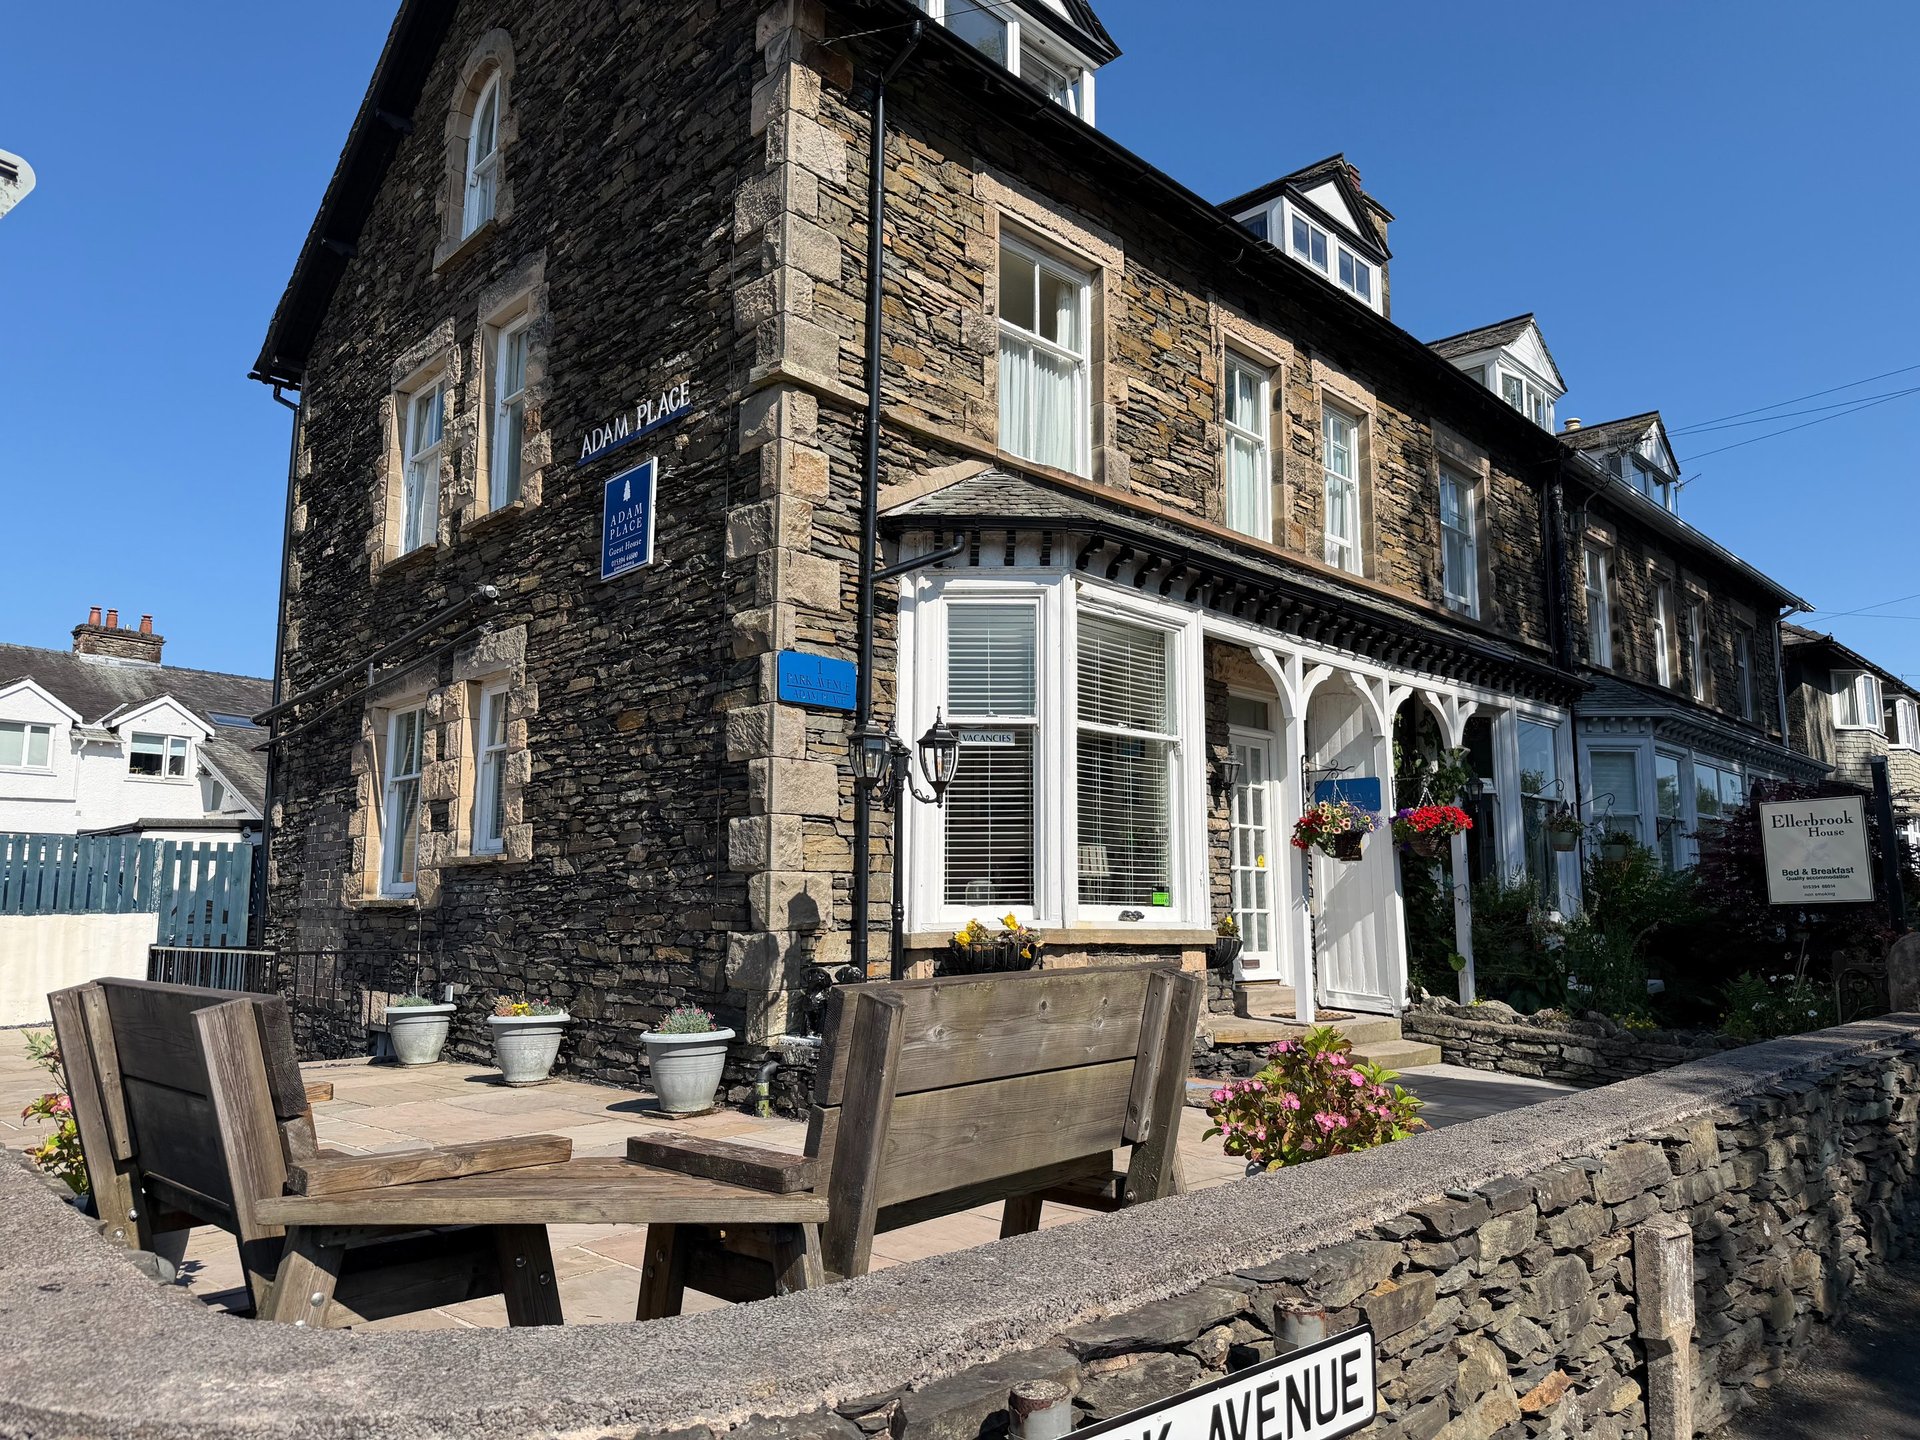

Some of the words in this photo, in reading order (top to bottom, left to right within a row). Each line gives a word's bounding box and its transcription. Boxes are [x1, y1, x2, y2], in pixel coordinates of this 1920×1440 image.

[581, 413, 629, 459] ADAM
[636, 380, 690, 431] PLACE
[610, 502, 643, 527] ADAM
[610, 516, 643, 540] PLACE
[608, 545, 624, 557] Guest
[625, 539, 642, 551] House
[786, 672, 813, 687] PARK
[815, 677, 851, 693] AVENUE
[793, 689, 819, 702] ADAM
[962, 733, 1011, 742] VACANCIES
[1771, 810, 1854, 829] Ellerbrook
[1808, 827, 1845, 838] House
[1781, 868, 1799, 877] Bed
[1801, 868, 1809, 876] &
[1811, 866, 1855, 875] Breakfast
[1209, 1348, 1364, 1440] AVENUE
